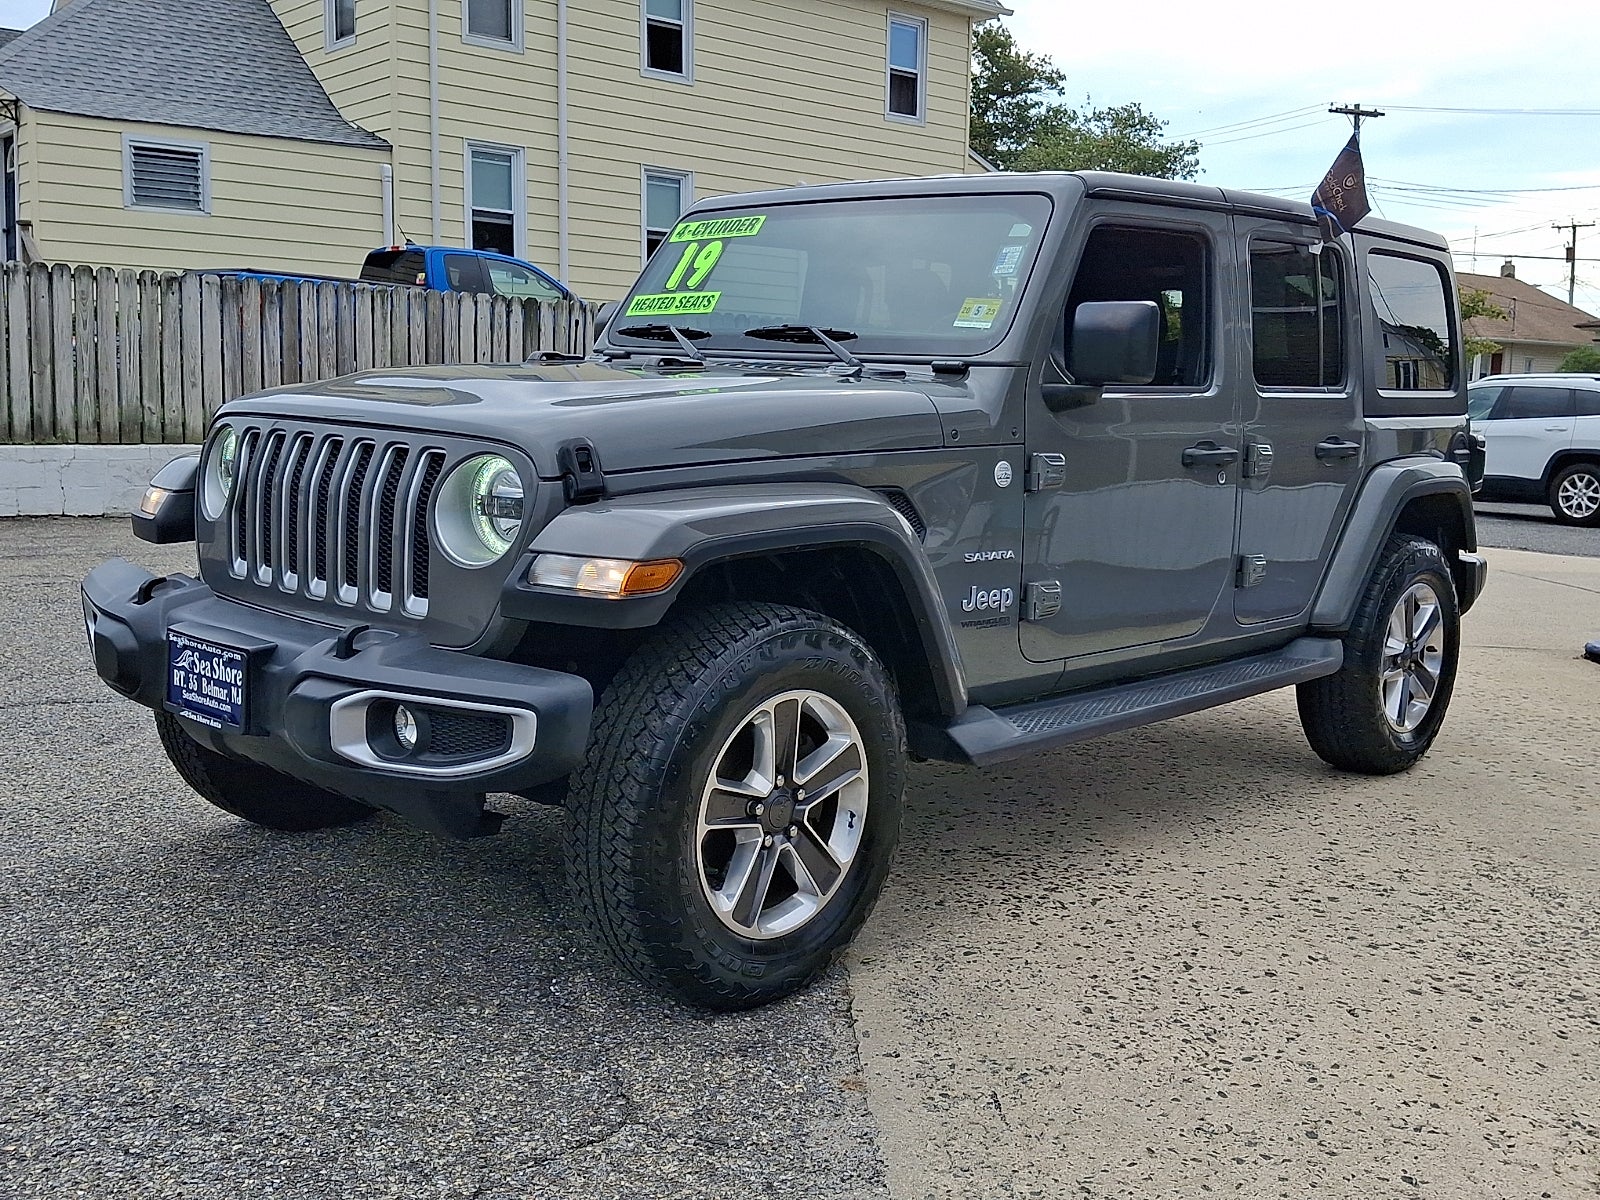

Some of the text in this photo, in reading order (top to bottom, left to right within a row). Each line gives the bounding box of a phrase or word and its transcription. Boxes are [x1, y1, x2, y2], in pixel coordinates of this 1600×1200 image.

[674, 217, 761, 239] 4-CYLINDER
[665, 240, 723, 291] 19
[631, 295, 716, 312] HEATED SEATS
[974, 306, 982, 316] 5
[964, 550, 1015, 563] SAHARA
[962, 585, 1014, 612] Jeep
[169, 634, 241, 660] SeaShoreAuto.com
[193, 652, 243, 686] Sea Shore
[173, 669, 242, 705] RT. 35 Belmar, NJ
[182, 690, 232, 713] SeaShoreAuto.com
